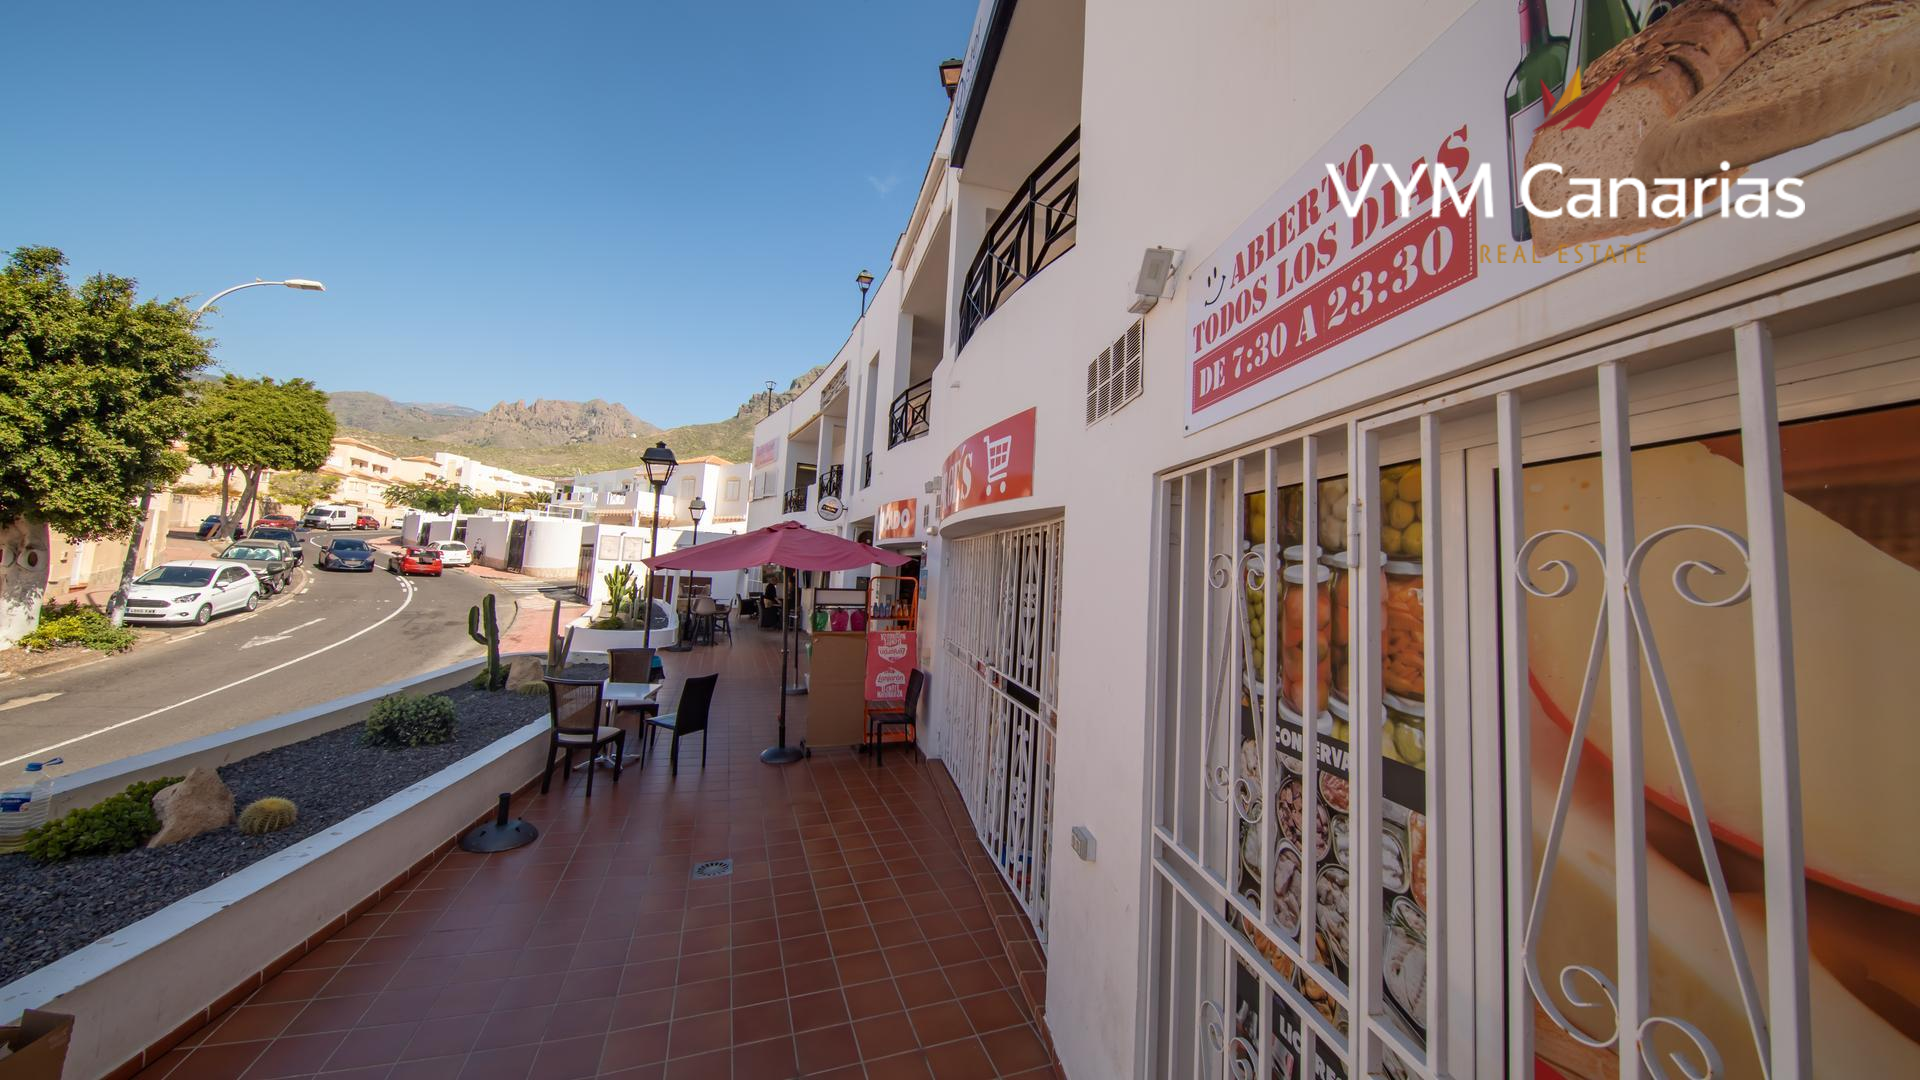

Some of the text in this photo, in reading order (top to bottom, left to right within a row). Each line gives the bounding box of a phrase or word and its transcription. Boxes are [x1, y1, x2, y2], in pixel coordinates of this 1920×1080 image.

[1193, 273, 1267, 353] TODOS
[1276, 222, 1338, 299] LOS
[1230, 143, 1374, 289] ABIERTO
[1199, 225, 1454, 397] DE 7:30 A 23:30
